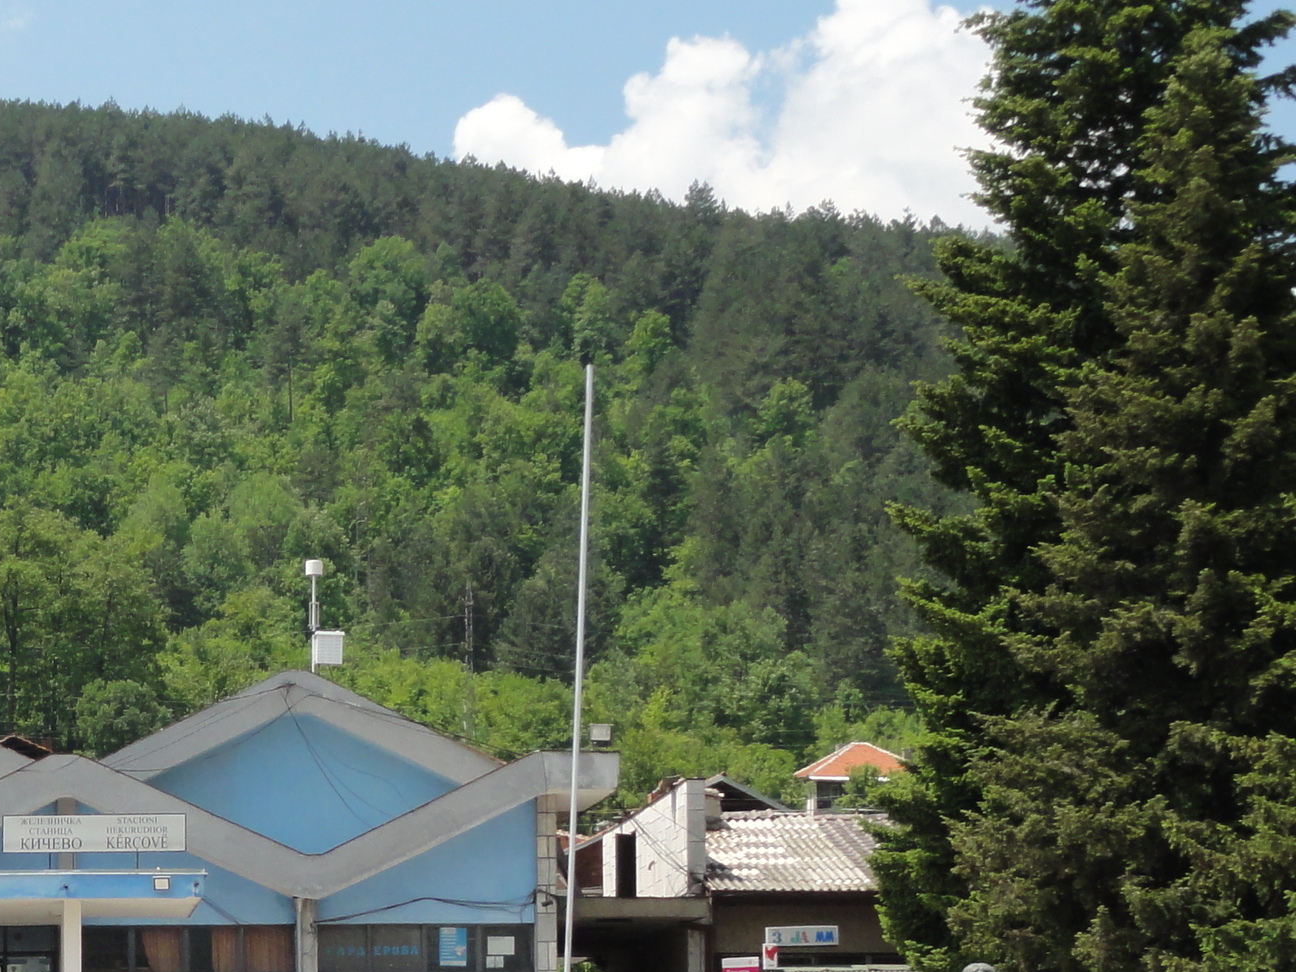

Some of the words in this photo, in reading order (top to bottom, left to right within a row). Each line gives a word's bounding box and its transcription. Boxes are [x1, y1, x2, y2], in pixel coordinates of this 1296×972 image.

[117, 816, 158, 825] STACIONI
[29, 827, 73, 836] СТАНИЦА
[21, 837, 82, 850] КИЧЕВО
